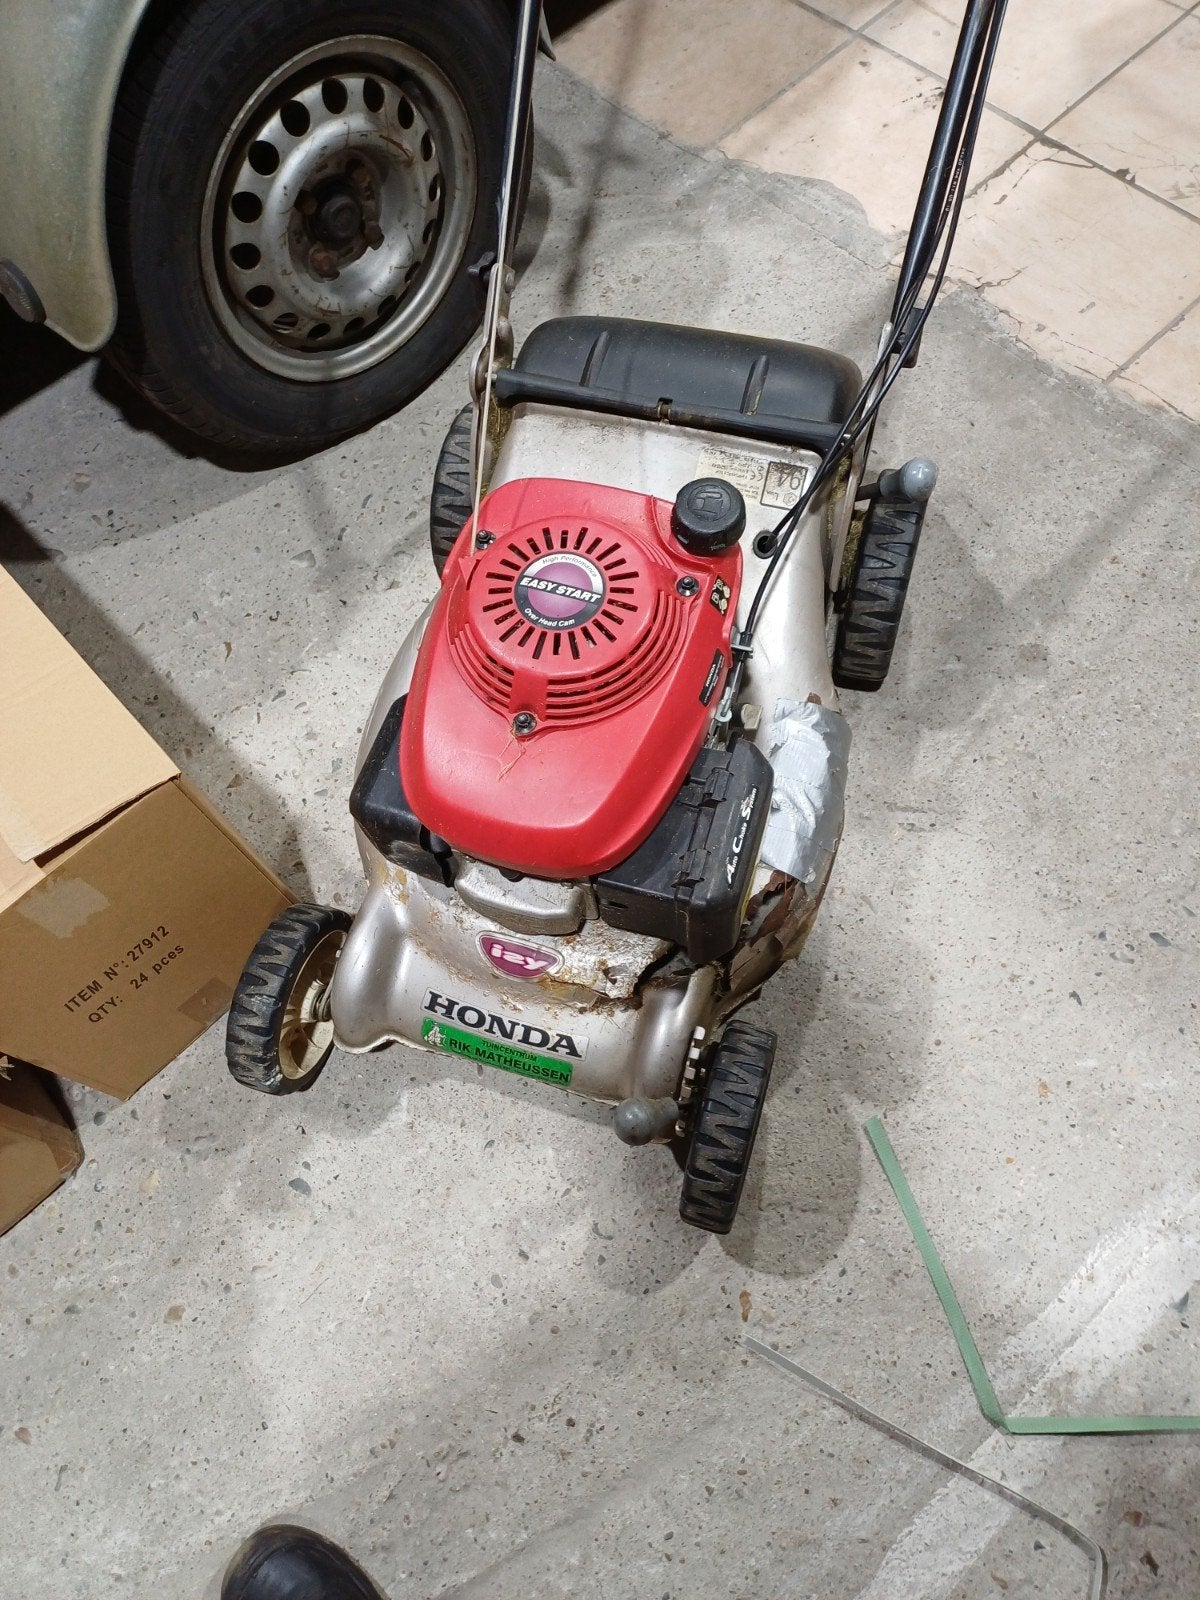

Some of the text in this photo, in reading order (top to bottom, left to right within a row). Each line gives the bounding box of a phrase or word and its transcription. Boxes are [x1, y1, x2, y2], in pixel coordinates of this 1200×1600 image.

[541, 555, 597, 578] High Performance
[519, 577, 602, 603] EASY START
[524, 607, 576, 627] Over Head Cam
[64, 979, 104, 1013] ITEM
[126, 925, 170, 962] 27912
[490, 943, 549, 971] izy
[88, 945, 184, 1023] QTY: 24 pces
[423, 990, 583, 1059] HONDA
[448, 1037, 471, 1054] RIK
[474, 1046, 571, 1083] MATHEUSSEN
[481, 1039, 538, 1063] TUINCENTRUM
